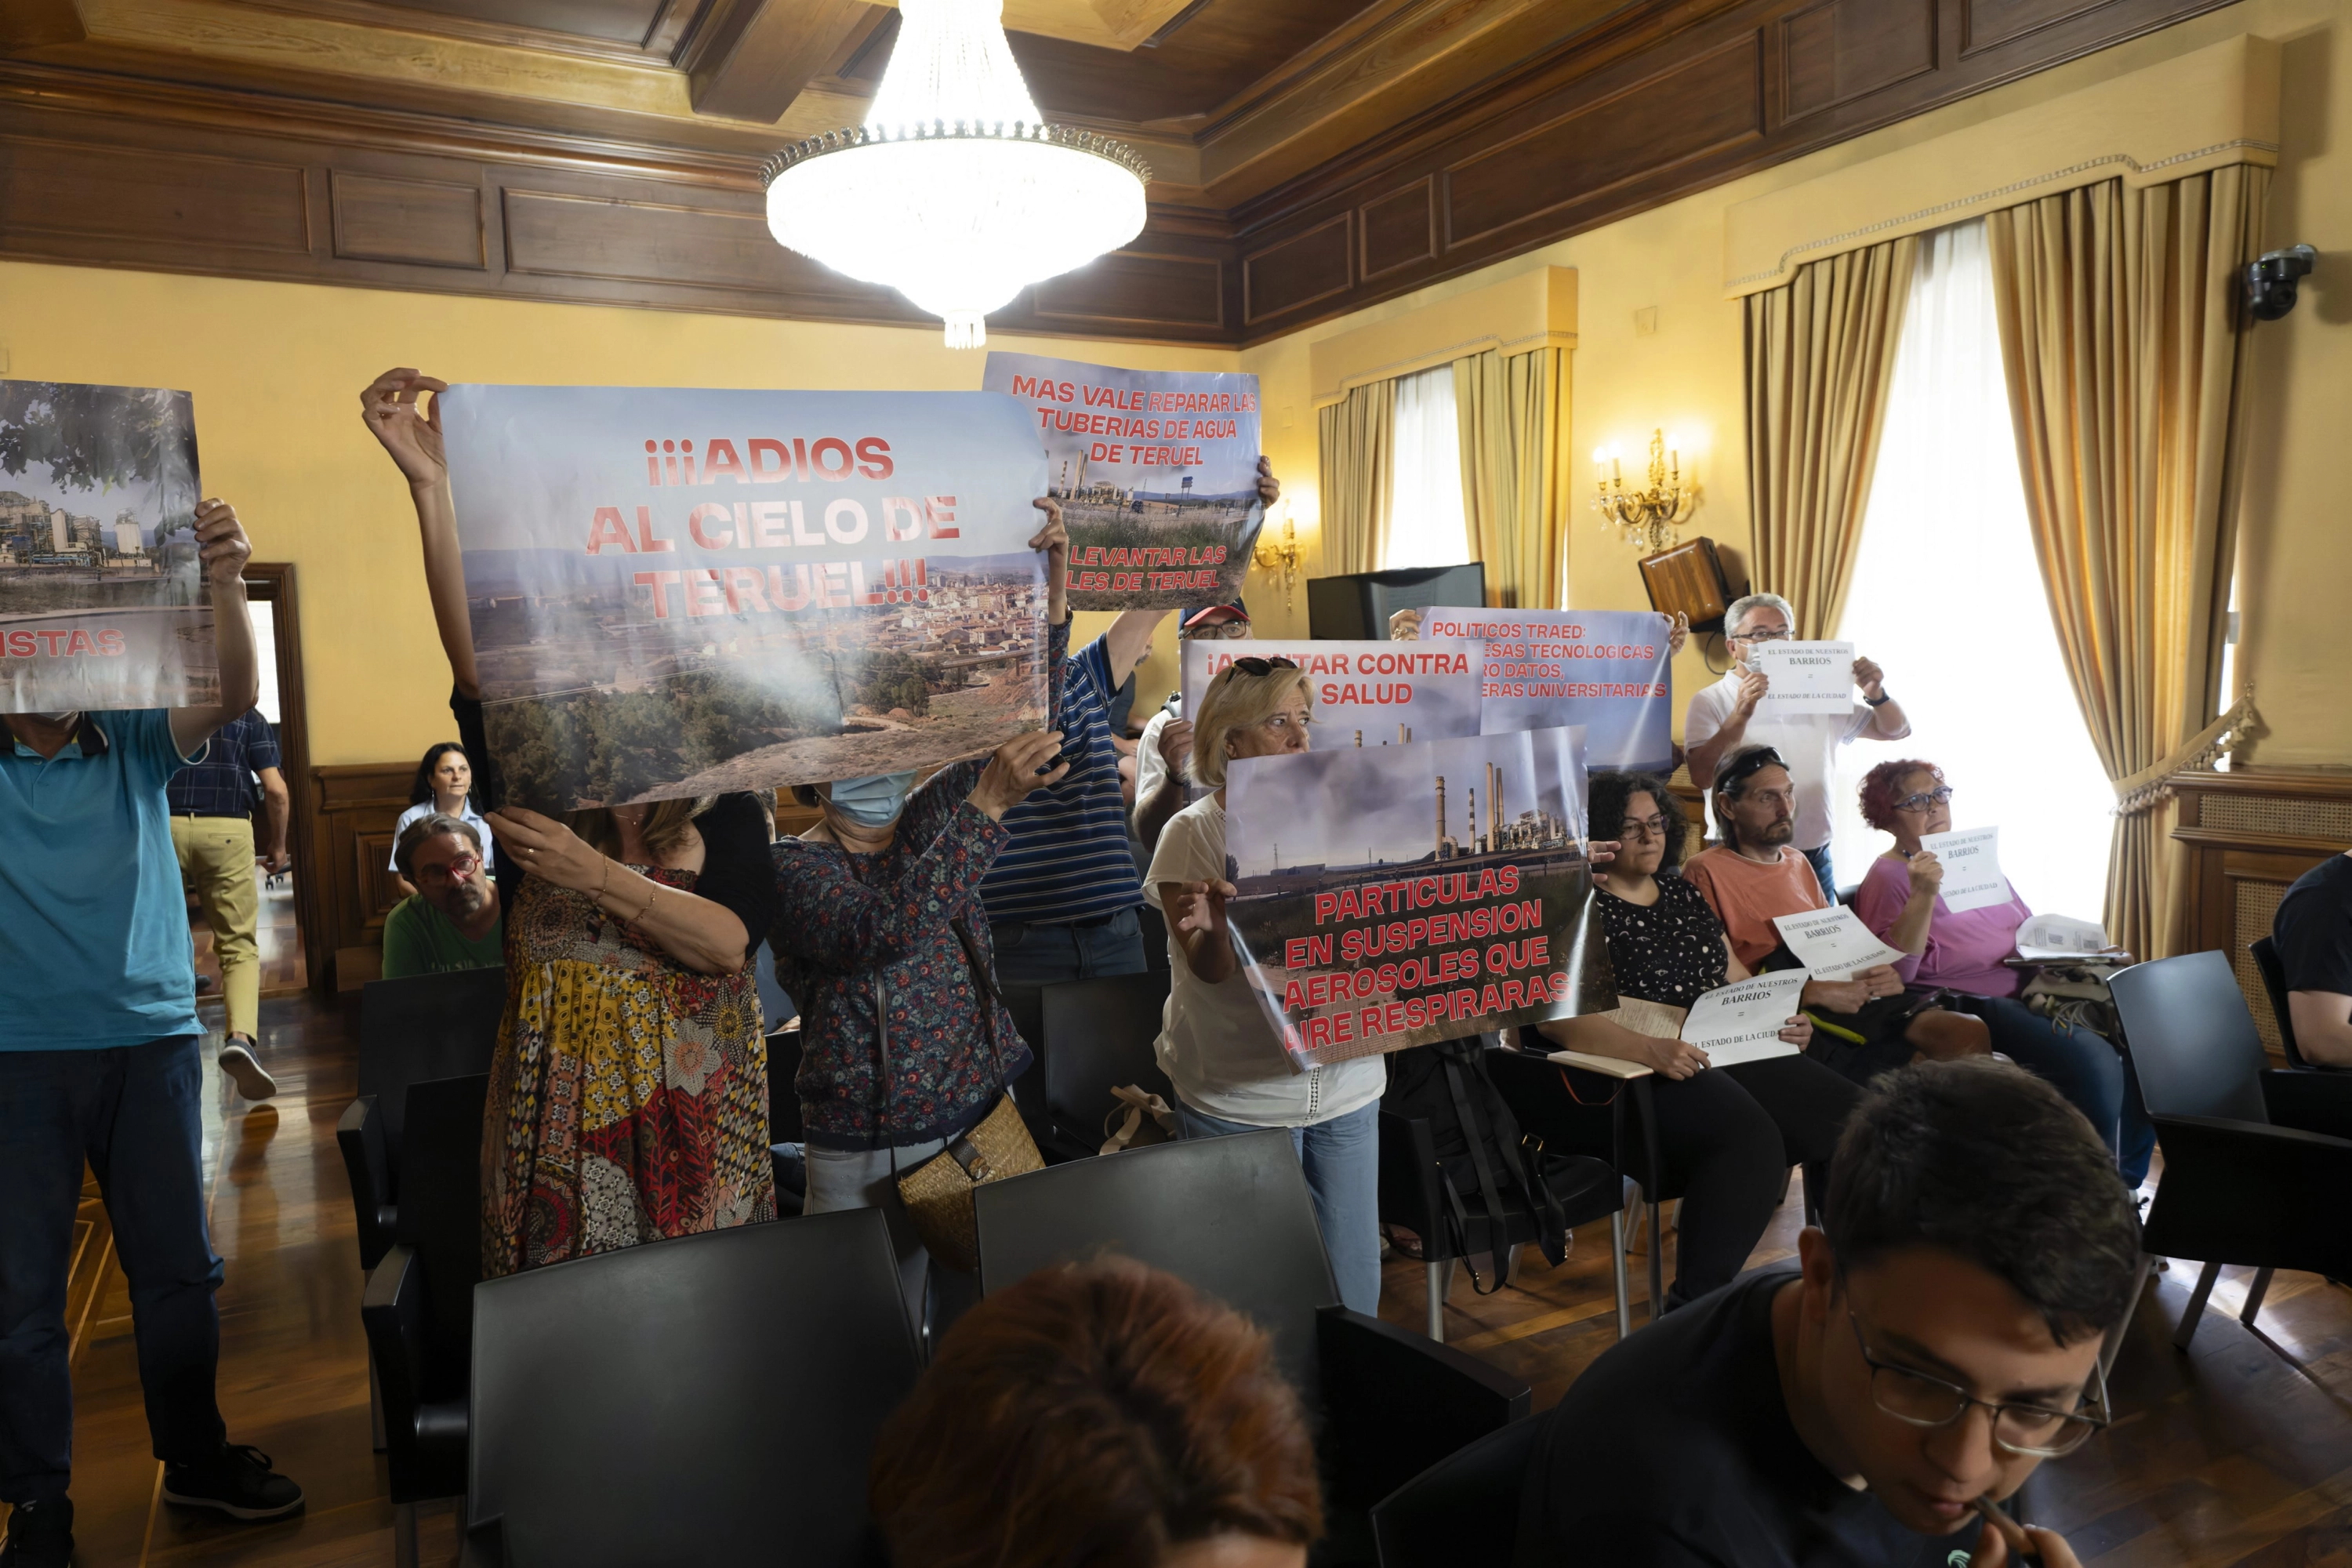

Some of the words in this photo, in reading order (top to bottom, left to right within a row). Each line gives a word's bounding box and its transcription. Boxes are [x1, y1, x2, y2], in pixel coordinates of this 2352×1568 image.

[1011, 374, 1076, 403] MAS
[1082, 385, 1145, 412] VALE
[1148, 392, 1232, 412] REPARAR
[1233, 393, 1256, 413] LAS
[1036, 406, 1160, 439] TUBERIAS
[1163, 419, 1190, 440] DE
[1192, 419, 1238, 440] AGUA
[644, 437, 894, 487] ¡¡¡ADIOS
[1090, 441, 1124, 463] DE
[1128, 445, 1204, 466] TERUEL
[585, 505, 675, 556] AL
[689, 498, 869, 550] CIELO
[882, 495, 961, 543] DE
[1069, 545, 1188, 567] LEVANTAR
[1189, 545, 1227, 564] LAS
[633, 557, 930, 619] TERUEL!!!
[1112, 572, 1145, 591] DE
[1146, 569, 1220, 591] TERUEL
[1432, 622, 1521, 638] POLITICOS
[1526, 623, 1586, 639] TRAED:
[1530, 644, 1654, 659] TECNOLOGICAS
[1207, 653, 1349, 676] ¡ATAR
[1357, 653, 1469, 675] CONTRA
[1504, 662, 1565, 681] DATOS,
[1321, 683, 1413, 705] SALUD
[1527, 682, 1667, 699] UNIVERSITARIAS
[1939, 840, 1960, 848] ESTADO
[1968, 833, 1994, 843] NUESTROS
[1948, 845, 1979, 858] BARRIOS
[1315, 864, 1519, 926] PARTICULAS
[1975, 882, 1998, 891] CIUDAD
[1792, 920, 1813, 930] ESTADO
[1820, 913, 1849, 925] NUESTROS
[1804, 924, 1842, 939] BARRIOS
[1285, 934, 1333, 971] EN
[1340, 898, 1543, 961] SUSPENSION
[1822, 964, 1842, 974] ESTADO
[1851, 957, 1863, 966] LA
[1861, 949, 1886, 963] CIUDAD
[1283, 949, 1479, 1014] AEROSOLES
[1486, 935, 1551, 978] QUE
[1715, 985, 1744, 997] ESTADO
[1745, 982, 1755, 991] DE
[1757, 978, 1798, 989] NUESTROS
[1721, 989, 1772, 1006] BARRIOS
[1283, 1011, 1354, 1054] AIRE
[1361, 971, 1573, 1039] RESPIRARAS
[1701, 1037, 1732, 1048] ESTADO
[1733, 1035, 1744, 1044] DE
[1745, 1032, 1756, 1041] LA
[1756, 1030, 1777, 1040] CIUD
